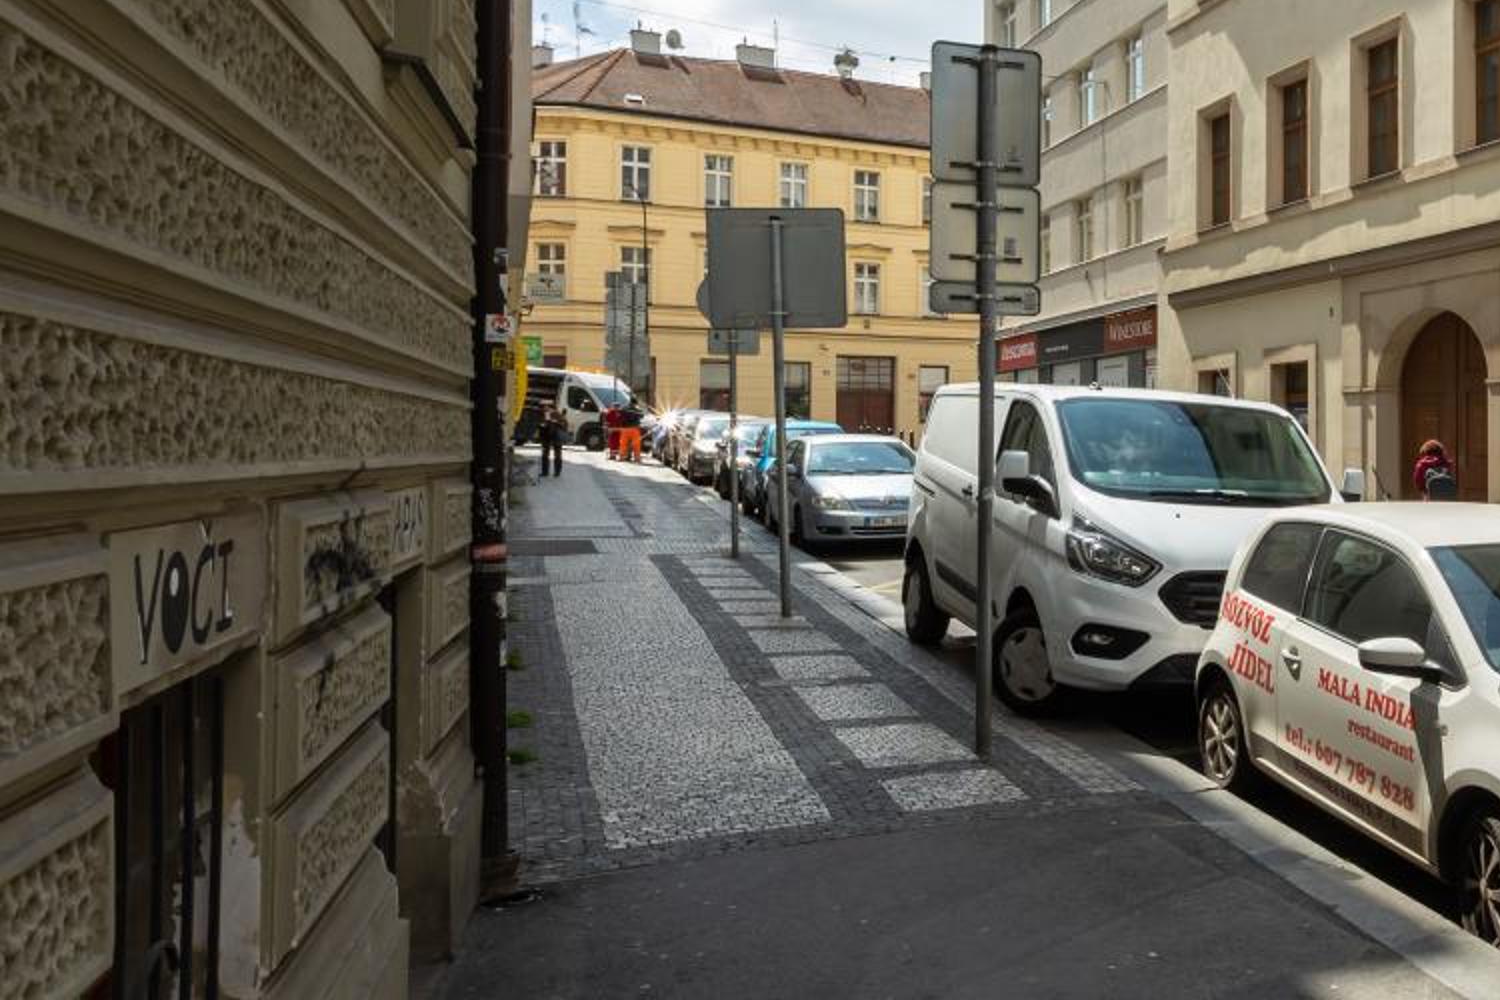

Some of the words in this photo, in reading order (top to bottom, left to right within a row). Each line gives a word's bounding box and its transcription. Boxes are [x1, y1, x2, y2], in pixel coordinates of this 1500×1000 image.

[1222, 590, 1275, 645] ROZVOZ
[1228, 640, 1274, 694] JÍDEL
[1318, 667, 1361, 706] MALA
[1366, 687, 1418, 730] INDIA
[1348, 718, 1415, 762] restaurant
[1315, 739, 1342, 774] 607
[1346, 757, 1377, 793] 787
[1381, 775, 1415, 811] 828
